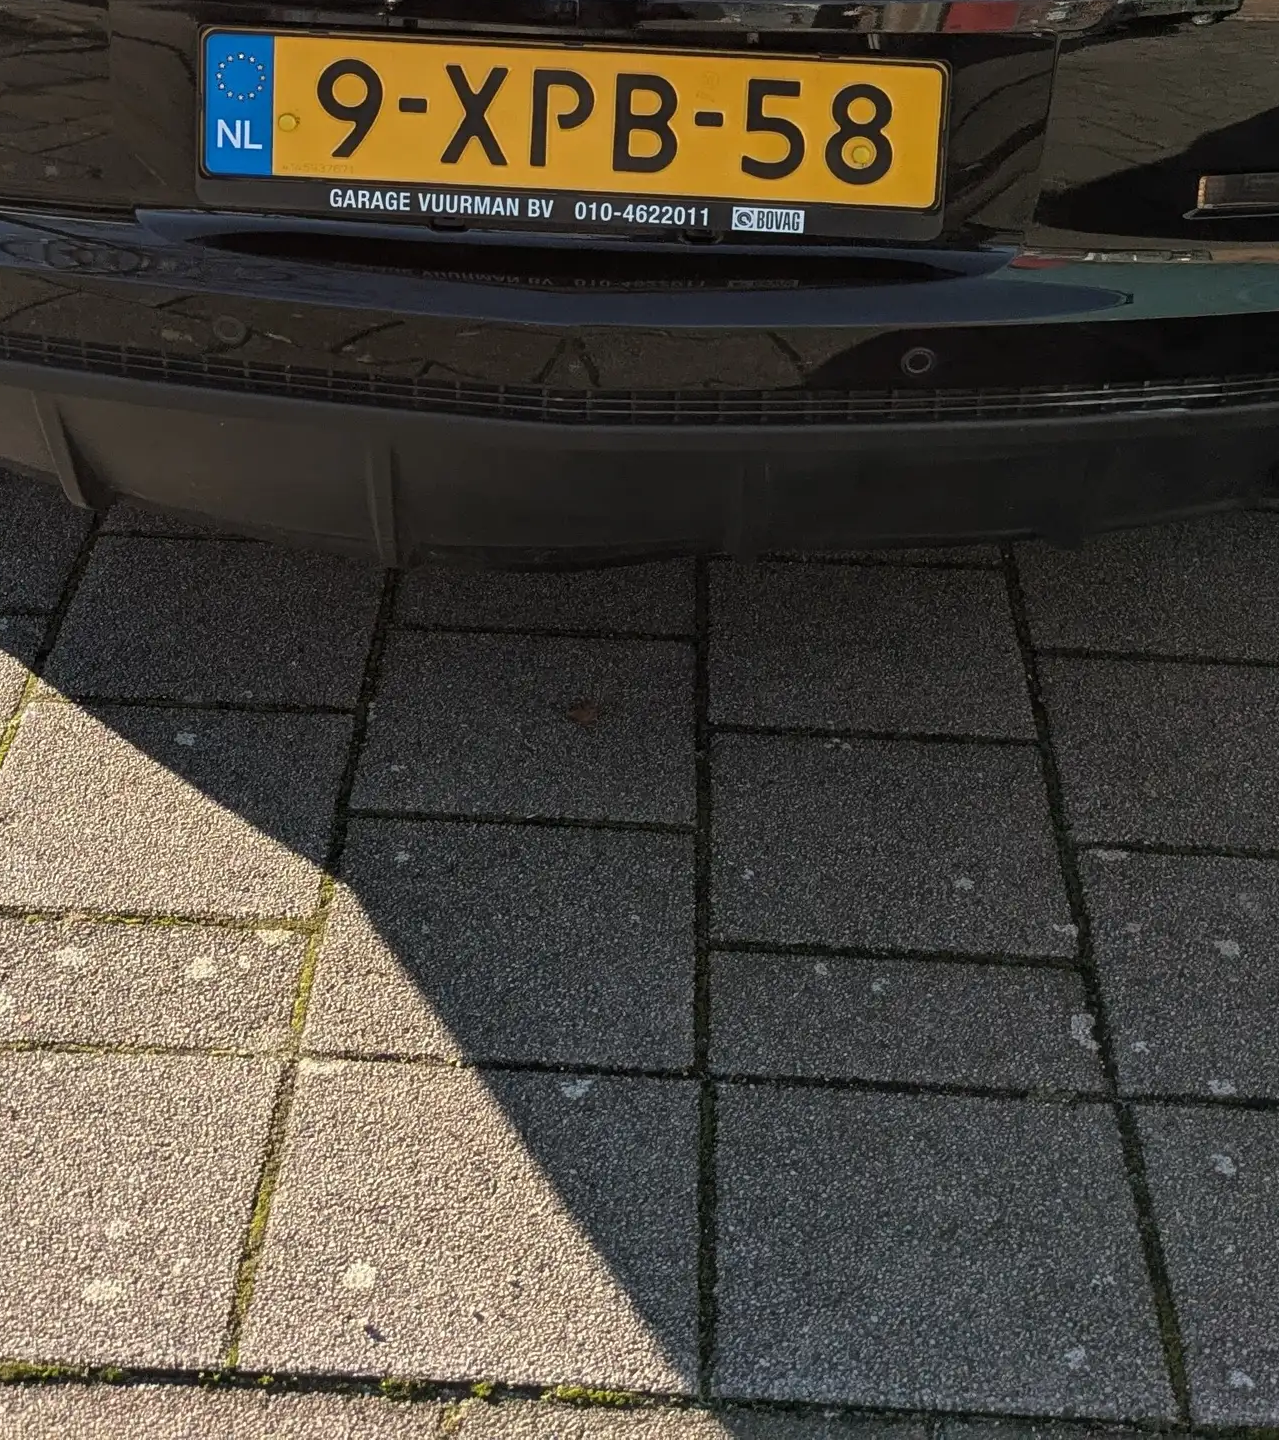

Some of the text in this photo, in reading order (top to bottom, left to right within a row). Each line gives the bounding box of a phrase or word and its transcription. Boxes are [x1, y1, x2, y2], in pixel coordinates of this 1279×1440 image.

[217, 118, 263, 150] NL
[316, 58, 894, 186] 9-XPB-58
[329, 188, 801, 232] GARAGE VUURMAN BV 010-4622011 BOVAG
